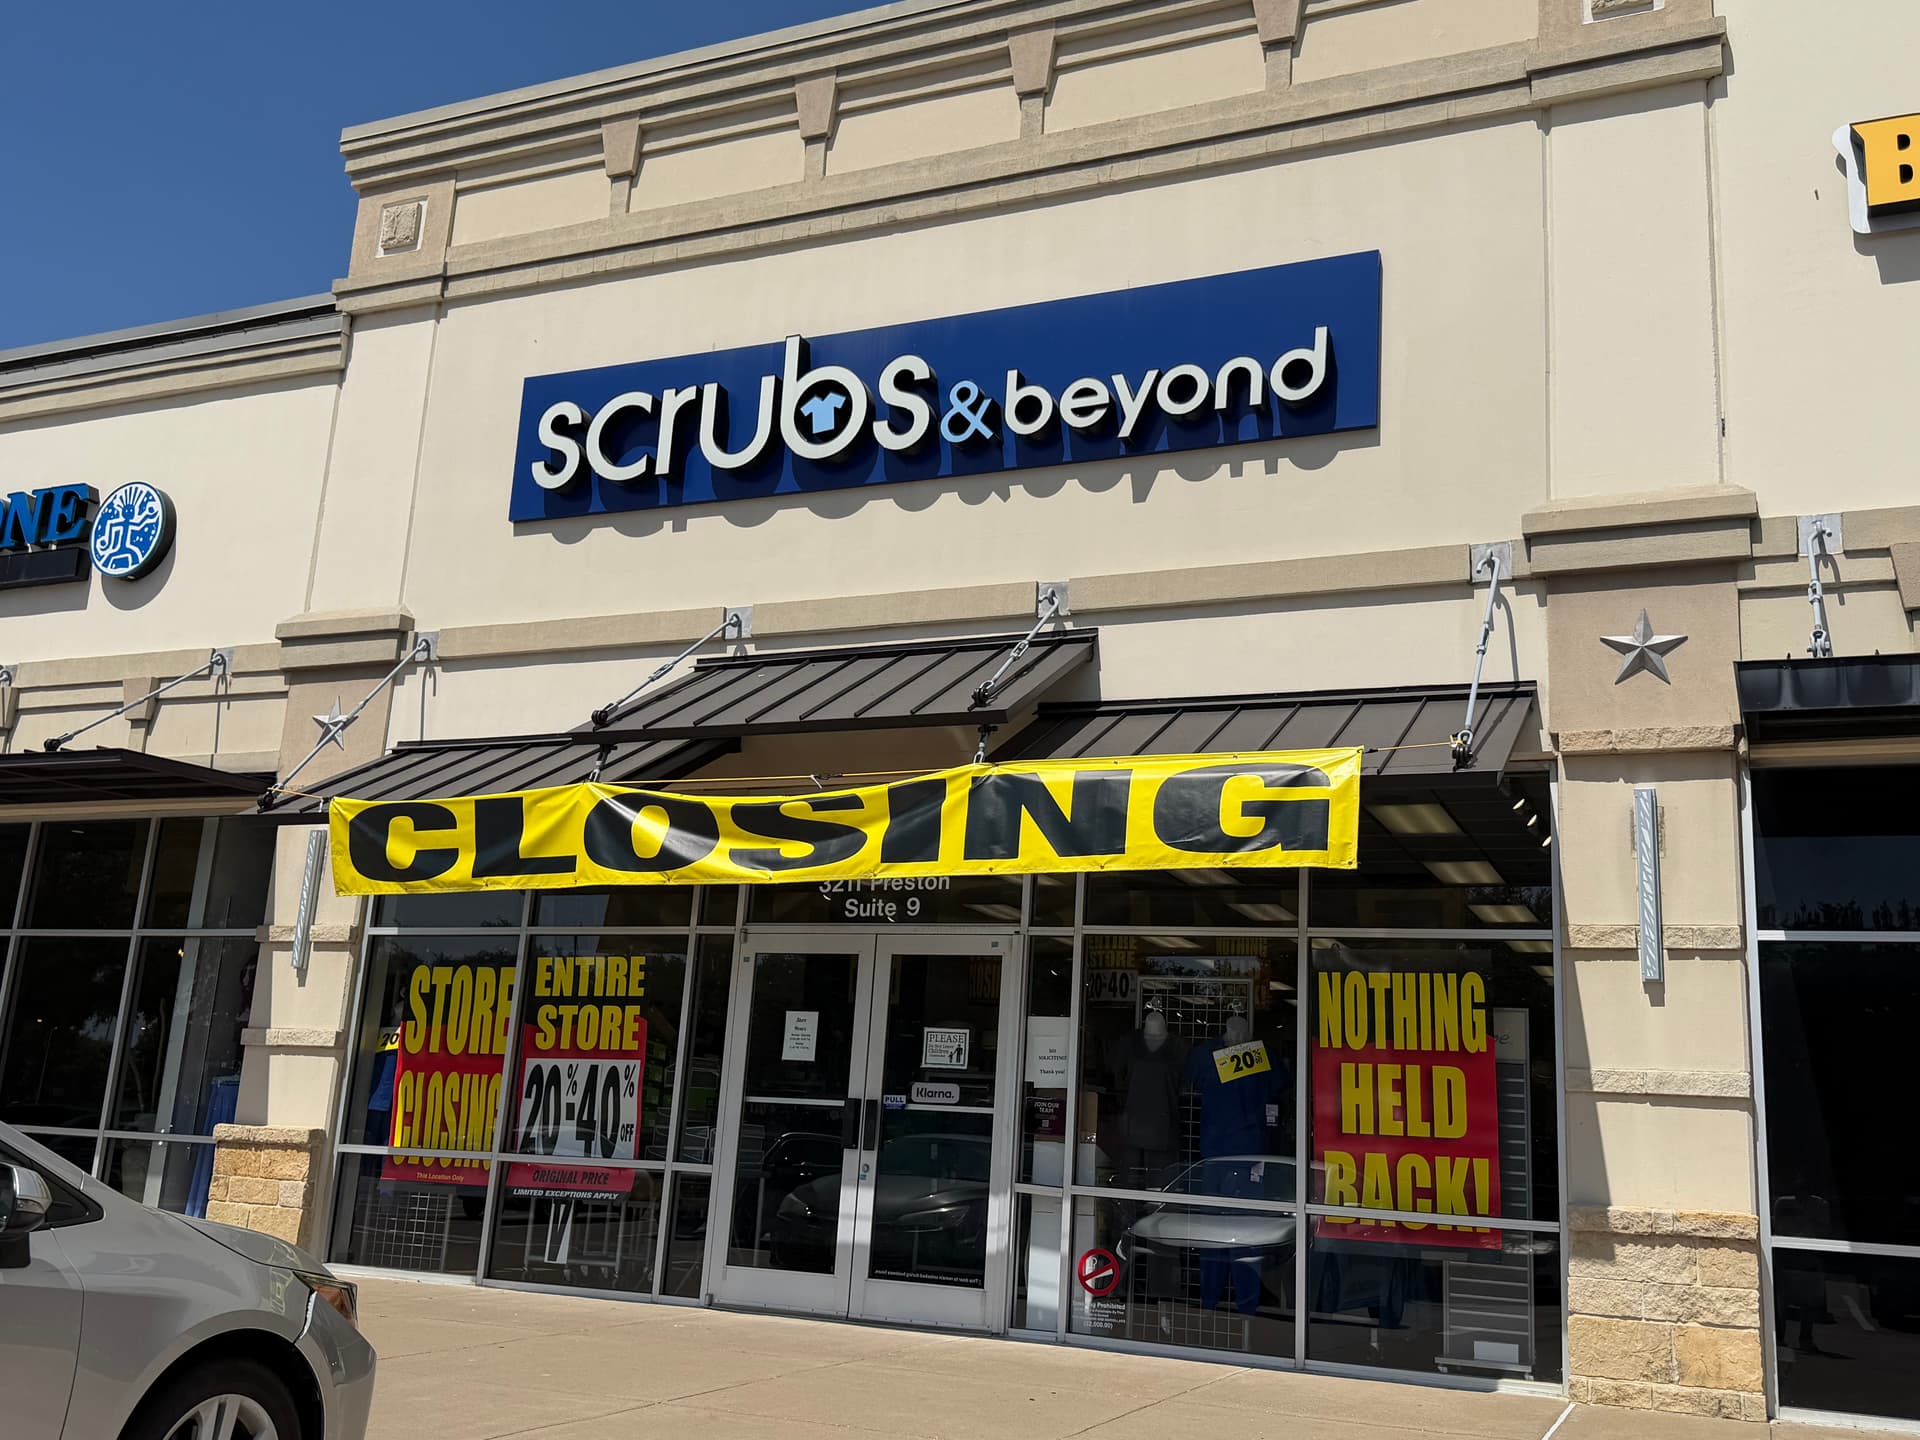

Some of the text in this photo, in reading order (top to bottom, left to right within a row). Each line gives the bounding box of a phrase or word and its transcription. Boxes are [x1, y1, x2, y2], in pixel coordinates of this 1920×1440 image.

[531, 325, 1328, 490] scrubs & beyond
[0, 482, 90, 549] NE
[347, 763, 1331, 883] CLOSING
[871, 876, 950, 891] Preston
[845, 897, 921, 917] Suite 9
[535, 955, 646, 997] ENTIRE
[404, 965, 517, 1055] STORE
[535, 1004, 641, 1051] STORE
[1318, 970, 1487, 1054] NOTHING
[929, 1034, 964, 1043] PLEASE
[1340, 1062, 1468, 1139] HELD
[620, 1123, 634, 1142] OFF
[451, 1174, 465, 1182] Only
[513, 1188, 619, 1200] LIMITED EXCEPTIONS APPLY
[532, 1169, 610, 1185] ORIGINAL PRICE
[1323, 1150, 1490, 1234] BACK!
